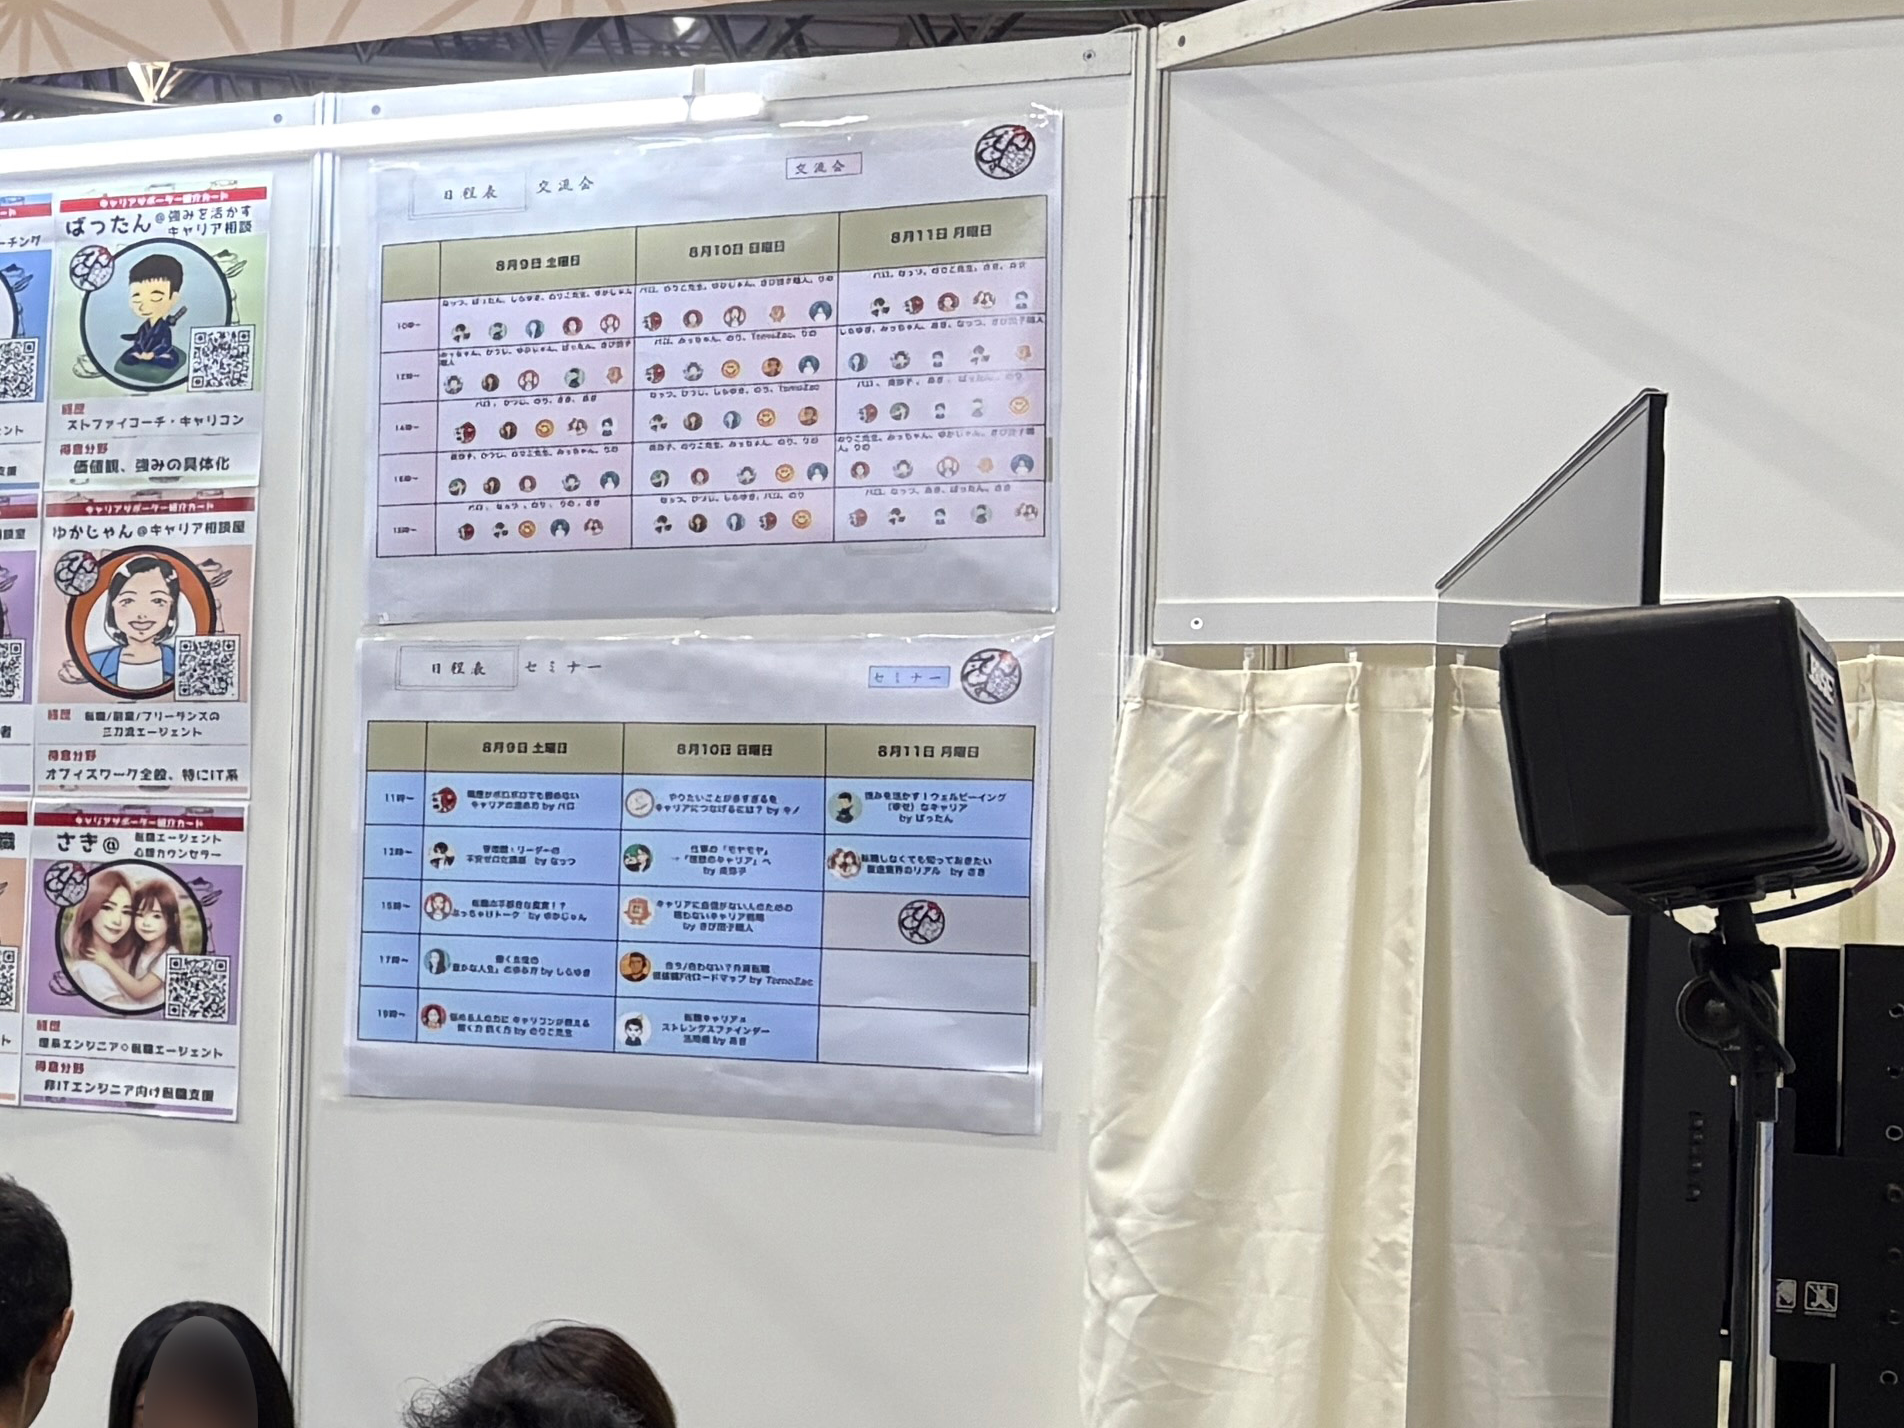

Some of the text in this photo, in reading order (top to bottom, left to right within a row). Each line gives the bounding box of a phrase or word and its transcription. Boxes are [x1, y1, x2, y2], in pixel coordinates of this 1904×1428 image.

[535, 176, 595, 194] 交流会
[66, 214, 151, 236] ばったん
[168, 220, 252, 237] キャリア相談
[890, 223, 993, 245] 8月11日 月曜日
[688, 242, 744, 260] 8月10日
[495, 252, 582, 274] 8月9日 土曜日
[67, 415, 244, 430] ストファイコーチ・キャリコン
[73, 456, 230, 474] 価値観、強みの具体化
[52, 519, 246, 540] ゆかじゃん@キャリア相談屋
[430, 658, 604, 677] 日程表 セミナー
[481, 739, 568, 756] 8月9日 土曜日
[676, 741, 773, 758] 8月10日 日曜日
[877, 745, 979, 758] 8月11日 月曜日
[45, 768, 239, 782] オフィスワーク全般、特にIT系
[56, 831, 120, 854] さき@
[134, 847, 222, 860] 心理カウンセラー
[44, 1079, 214, 1102] 非ITエンジニア向け転職支援
